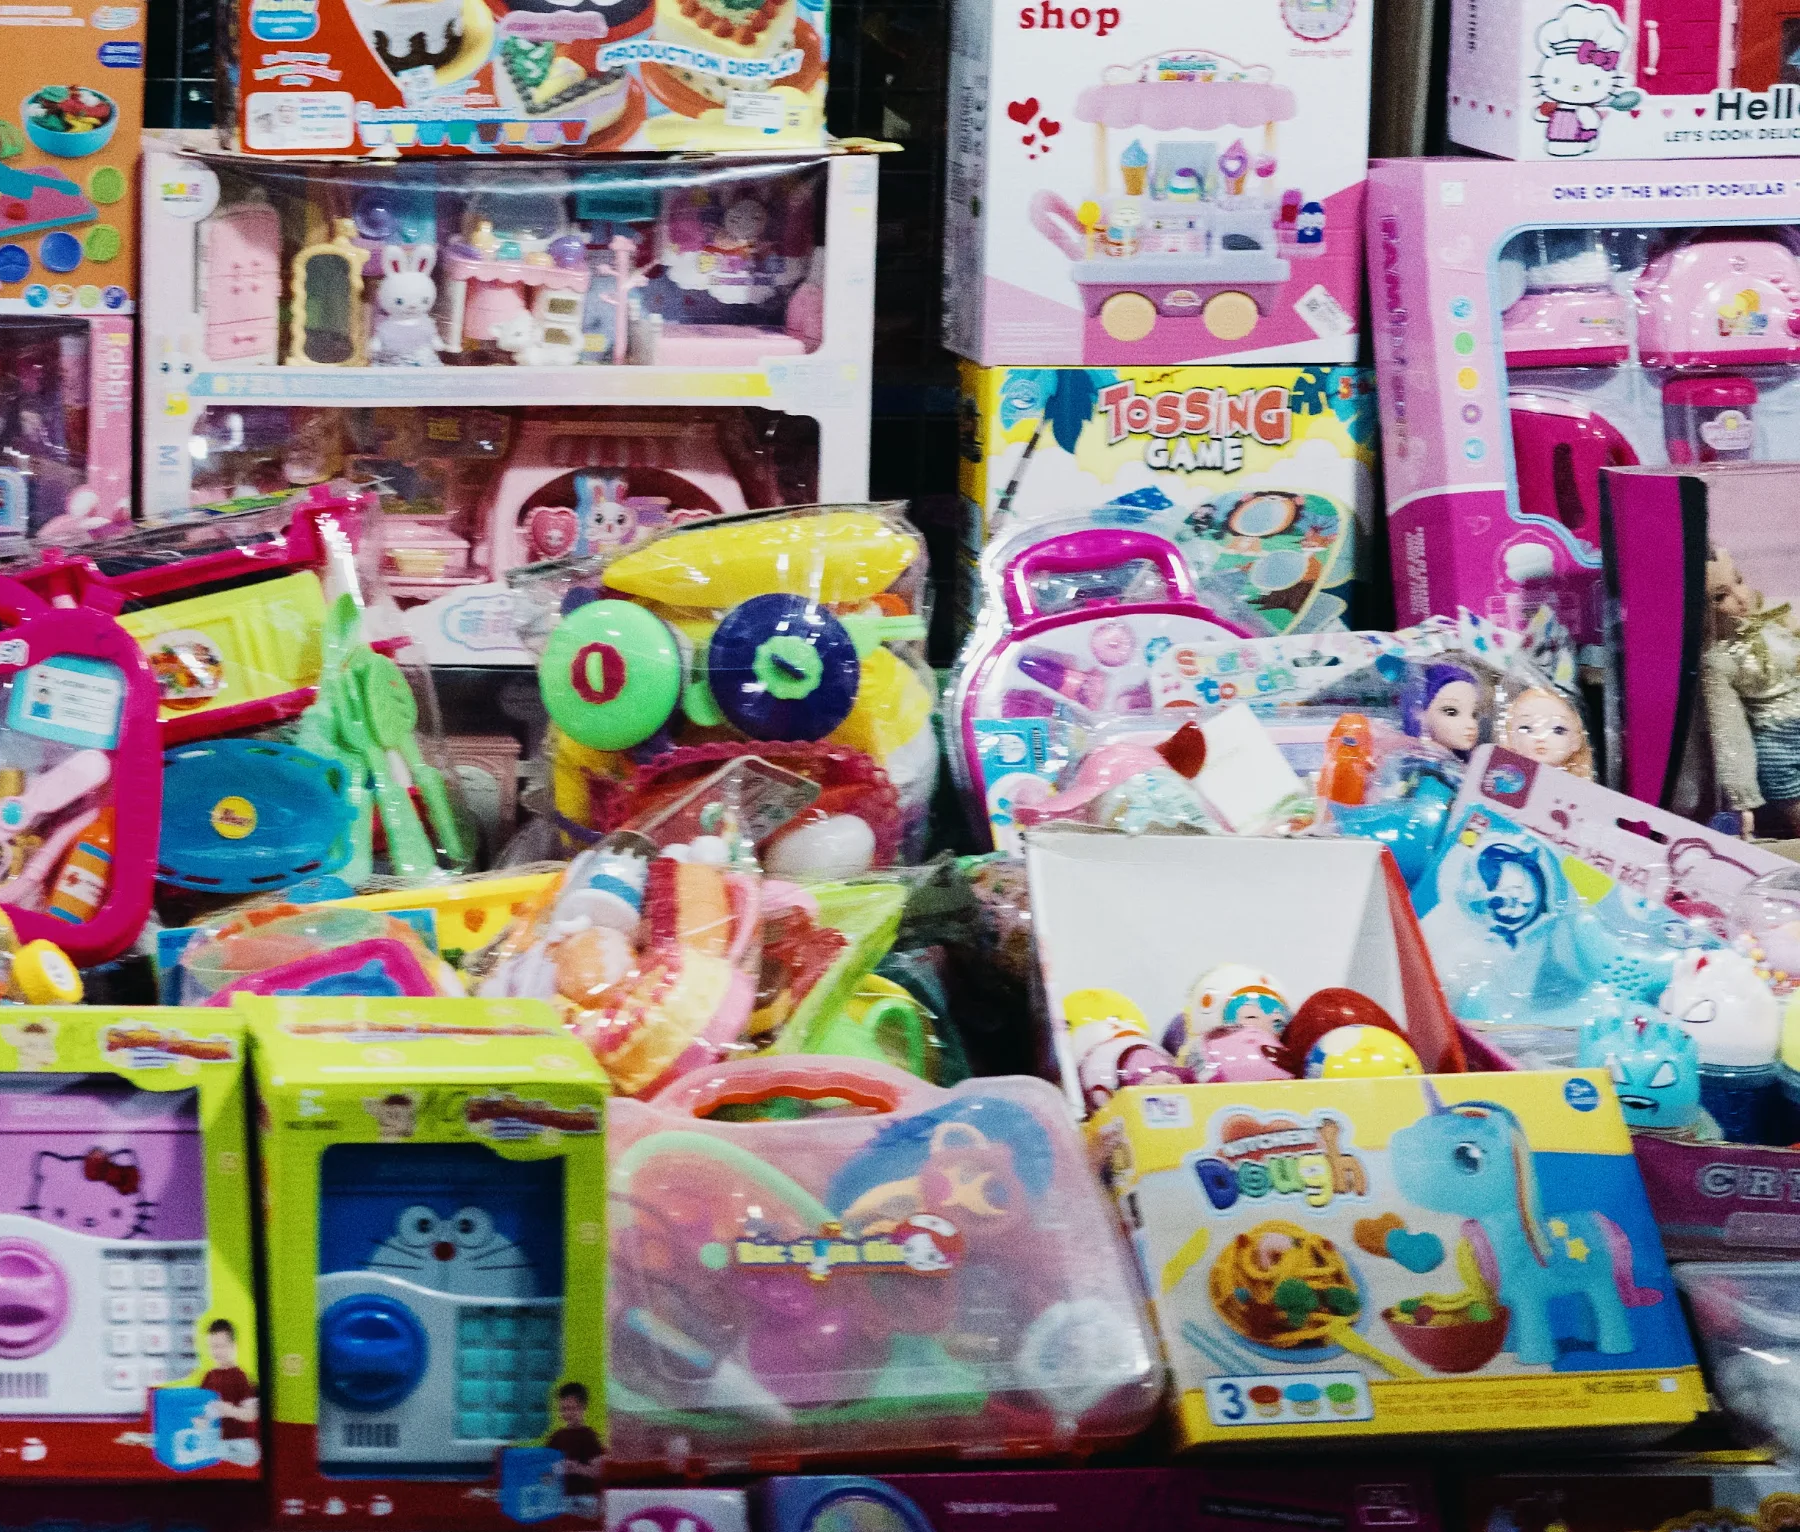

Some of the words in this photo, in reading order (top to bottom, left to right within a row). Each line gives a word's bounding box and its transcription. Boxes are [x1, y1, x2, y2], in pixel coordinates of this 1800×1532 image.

[1018, 1, 1121, 37] shop
[603, 43, 720, 71] PRODUCTION
[1664, 130, 1704, 142] LET'S
[1709, 129, 1752, 141] COOK
[1552, 186, 1589, 200] ONE
[1595, 185, 1616, 199] OF
[1621, 185, 1652, 199] THE
[1658, 184, 1700, 198] MOST
[1706, 182, 1786, 197] POPULAR
[1101, 380, 1291, 446] TOSSING
[1145, 438, 1245, 473] GAME
[1195, 1118, 1368, 1210] Dough
[1218, 1382, 1249, 1421] 3
